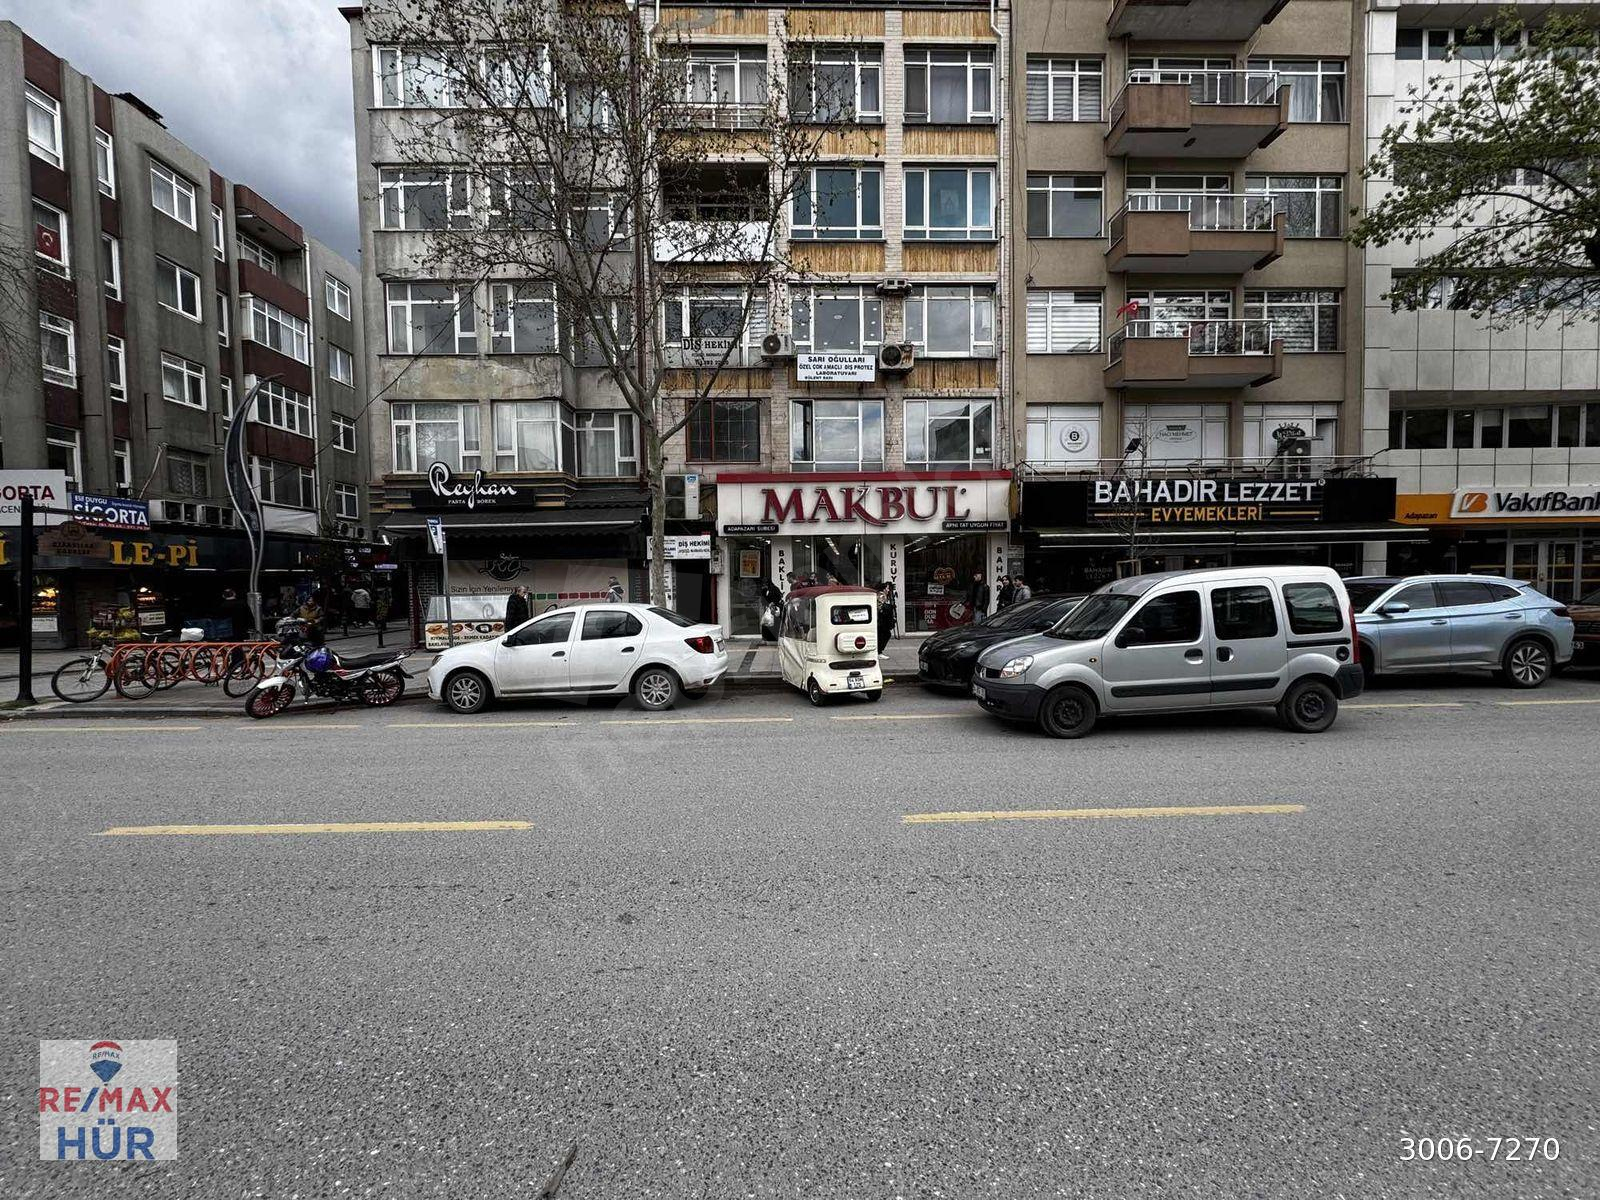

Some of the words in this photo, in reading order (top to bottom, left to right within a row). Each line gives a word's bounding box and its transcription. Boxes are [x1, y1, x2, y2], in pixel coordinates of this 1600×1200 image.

[828, 355, 865, 363] OĞULLARI
[845, 363, 853, 371] DİŞ
[0, 485, 55, 501] ORTA
[429, 462, 517, 509] Reyhan
[1095, 480, 1217, 503] BAHADIR
[1224, 482, 1317, 501] LEZZET
[85, 495, 108, 505] DUYGU
[760, 486, 971, 527] MAKBUL
[1151, 504, 1263, 522] EVYEMEKLERİ
[1404, 512, 1439, 520] Adapazarı
[679, 540, 688, 548] DİŞ
[690, 539, 710, 547] HEKİMİ
[111, 538, 199, 566] LE-Pİ
